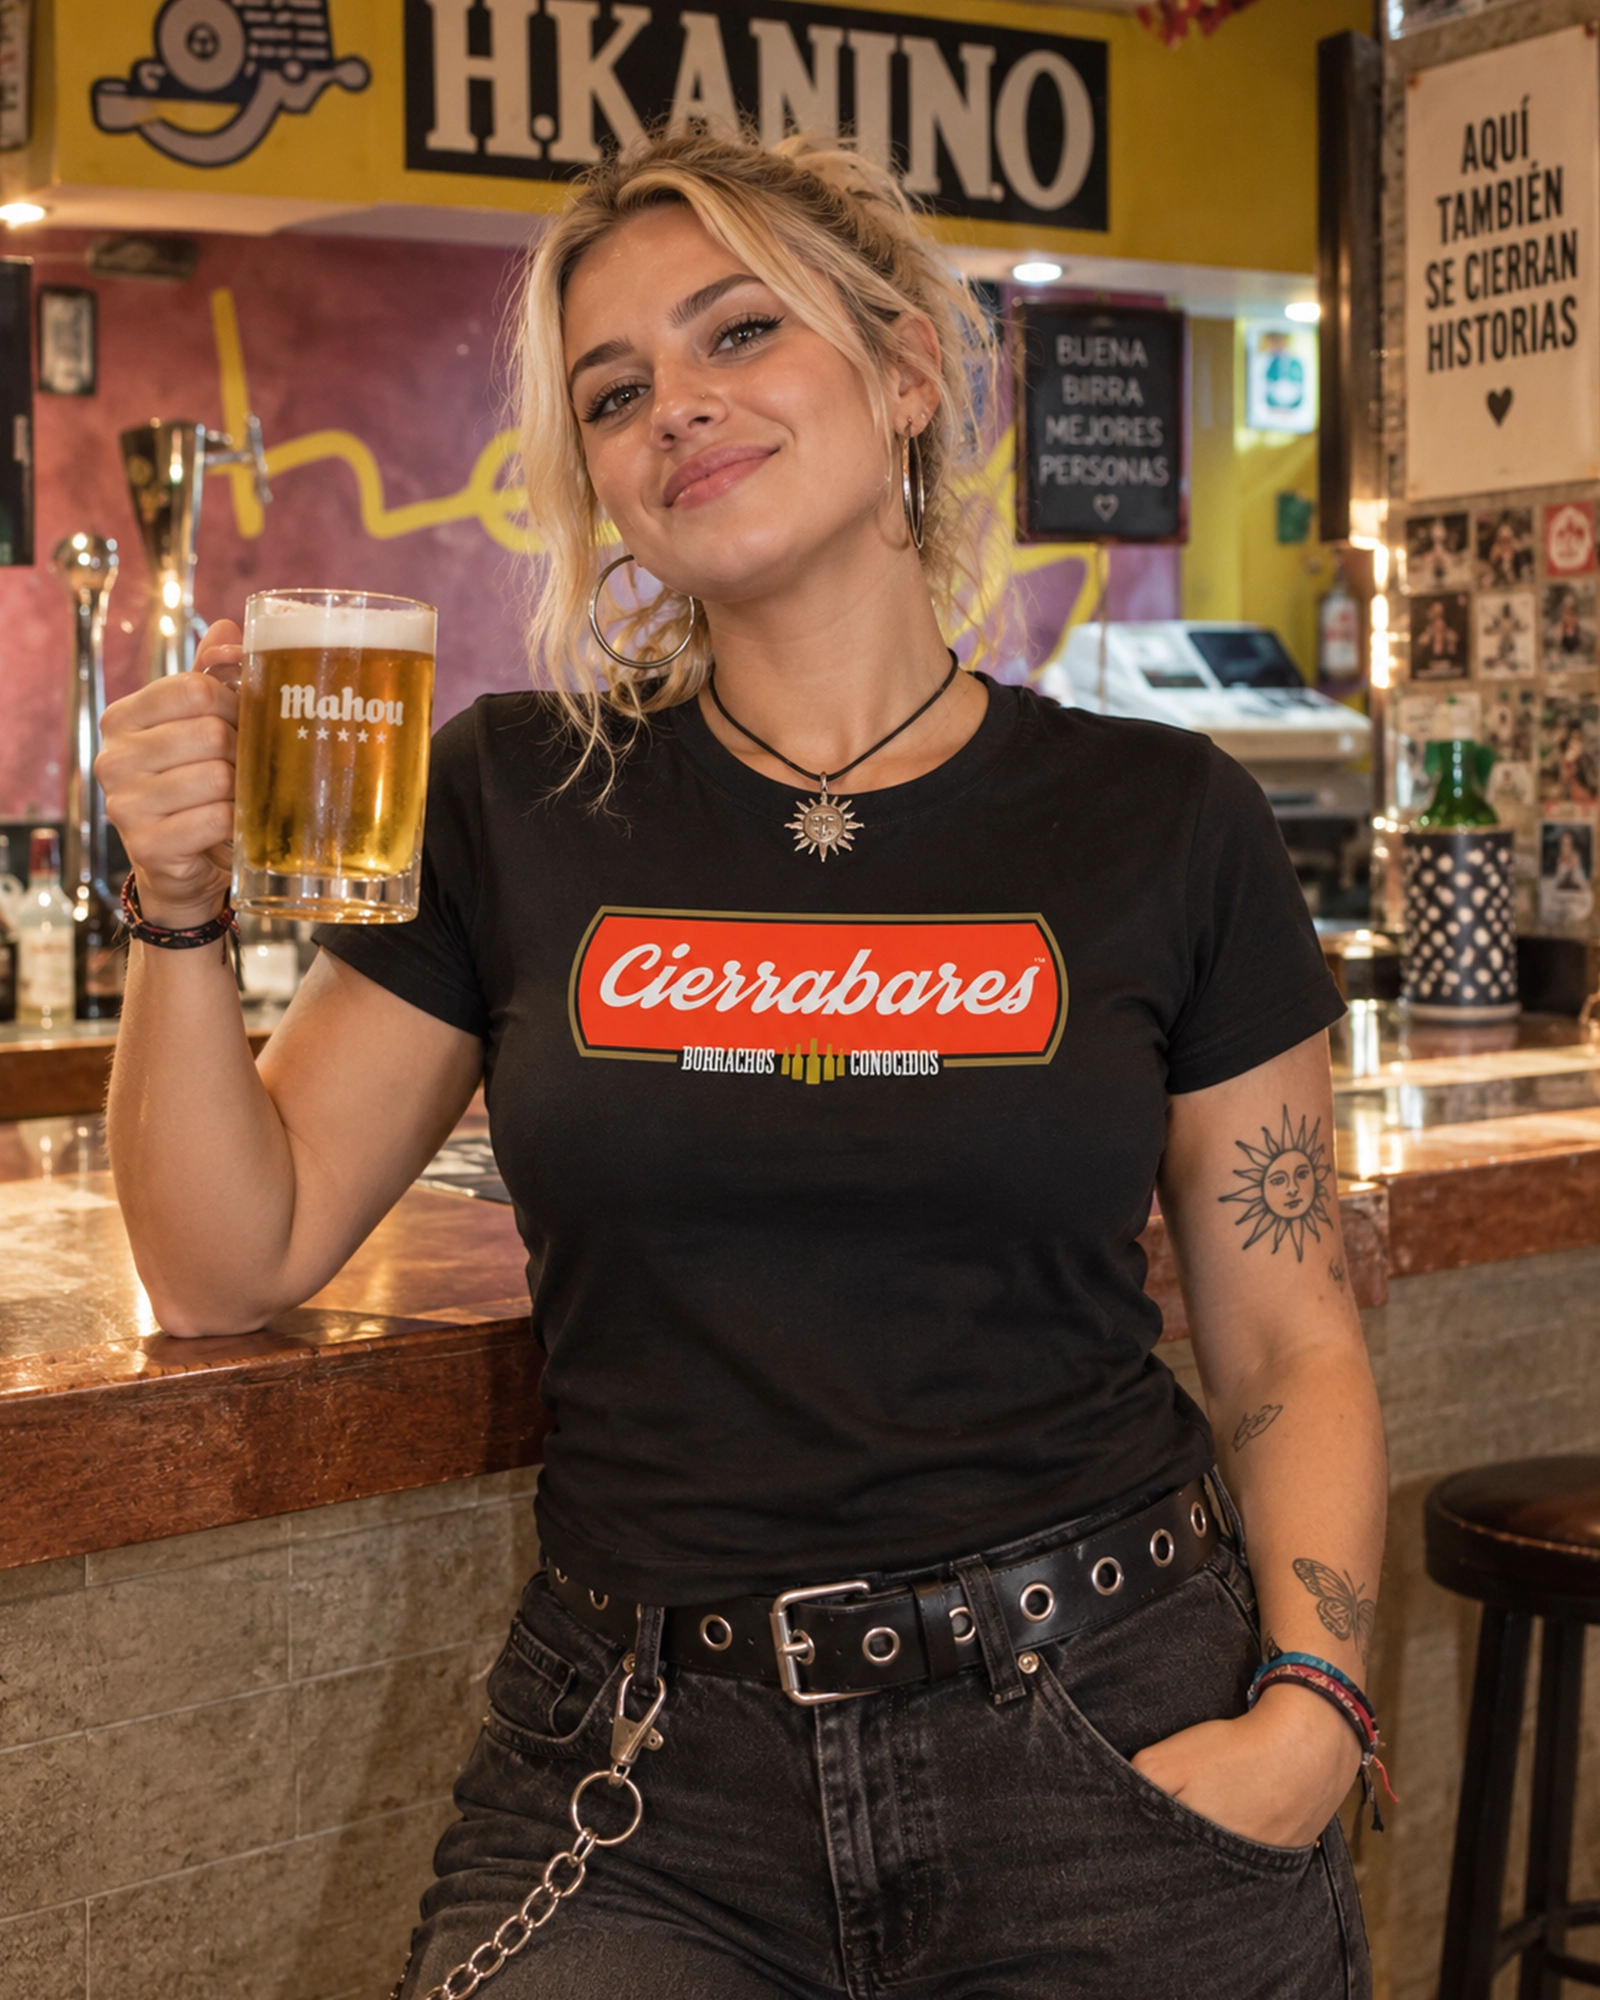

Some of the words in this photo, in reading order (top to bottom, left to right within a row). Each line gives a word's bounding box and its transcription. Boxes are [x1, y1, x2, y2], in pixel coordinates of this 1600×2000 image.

[1461, 94, 1530, 175] AQUÍ
[1436, 160, 1563, 246] TAMBIÉN
[1426, 258, 1455, 310] SE
[1464, 228, 1578, 302] CIERRAN
[1056, 334, 1148, 369] BUENA
[1427, 294, 1578, 374] HISTORIAS
[1061, 374, 1144, 408] BIRRA
[1045, 414, 1164, 448] MEJORES
[1039, 454, 1170, 487] PERSONAS
[279, 684, 404, 727] Mahou
[600, 943, 1040, 1016] Cierrabares
[681, 1045, 776, 1075] BORRACHOS
[849, 1050, 940, 1076] CONOCIDOS
